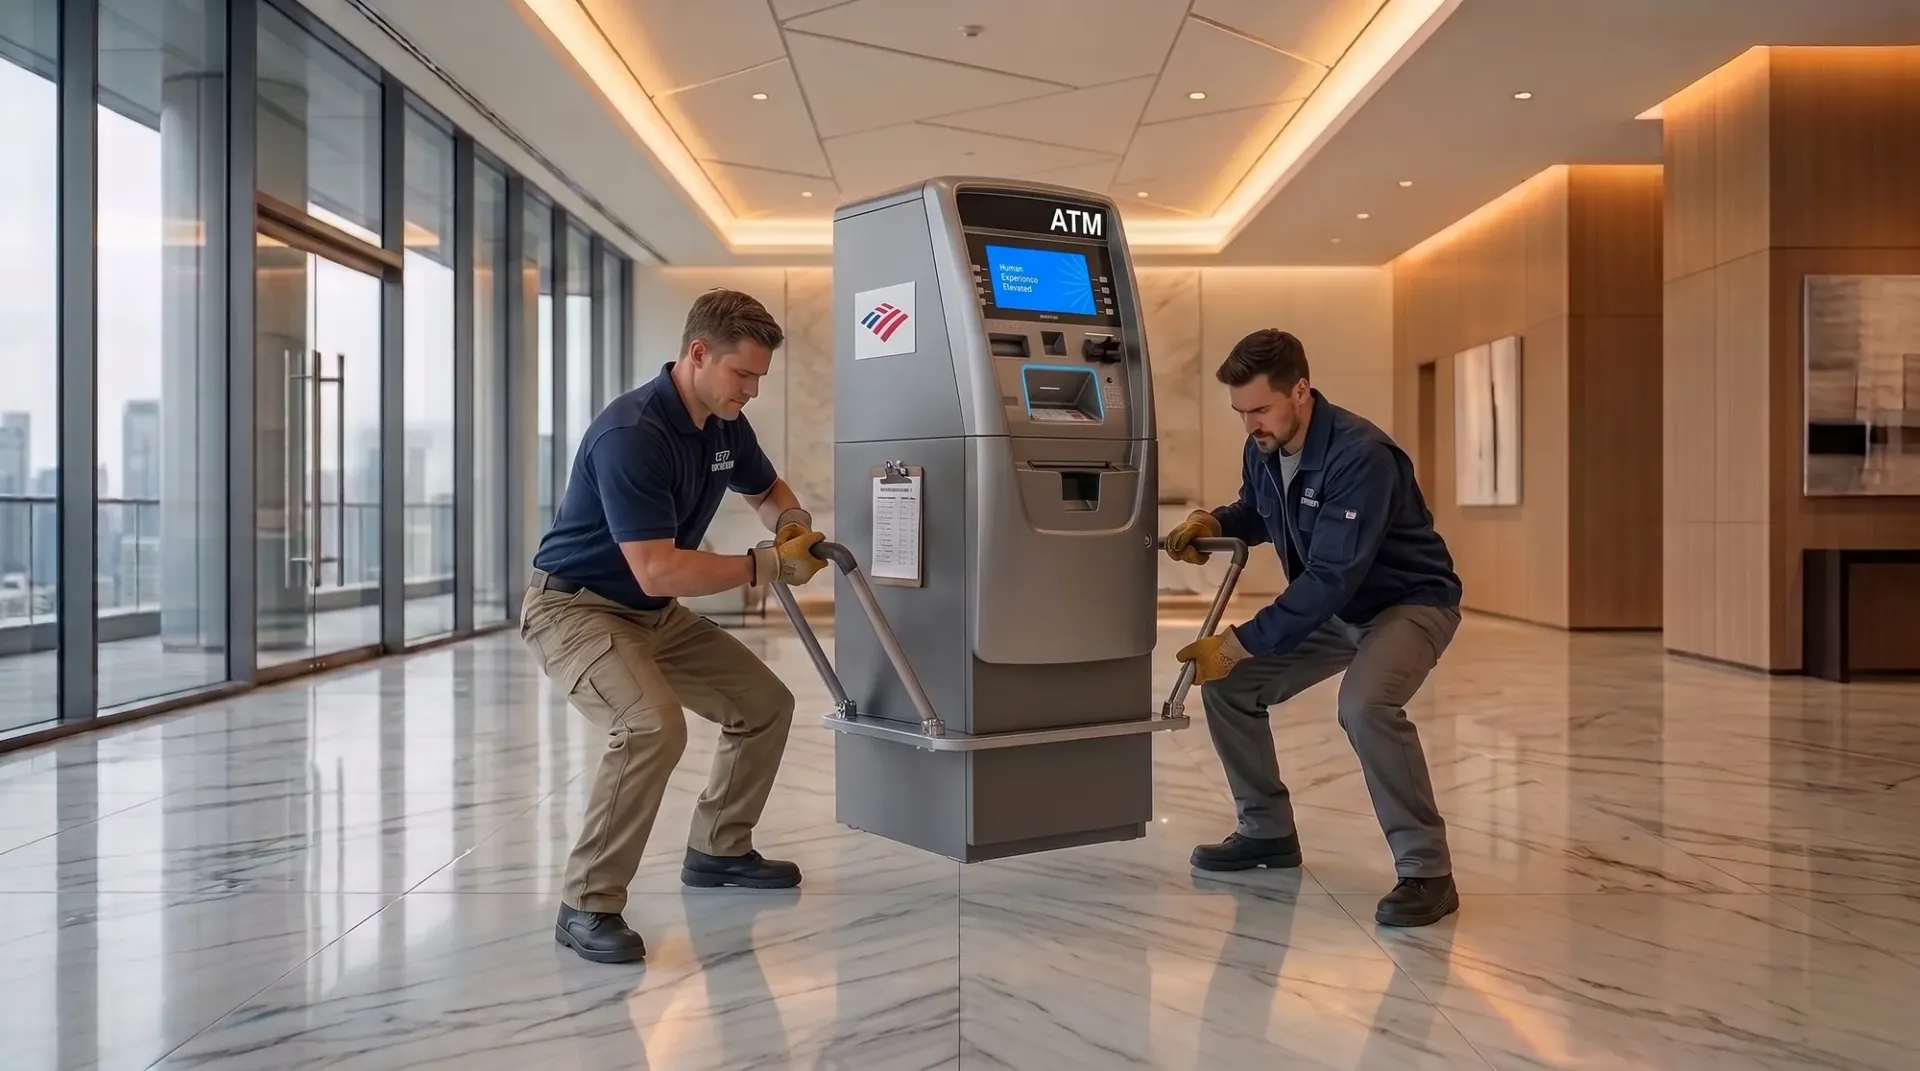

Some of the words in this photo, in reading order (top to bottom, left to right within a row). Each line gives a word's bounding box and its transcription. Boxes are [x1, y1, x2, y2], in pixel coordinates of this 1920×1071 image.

[1050, 208, 1102, 236] ATM
[999, 263, 1024, 272] Human
[1003, 283, 1033, 293] Elevated
